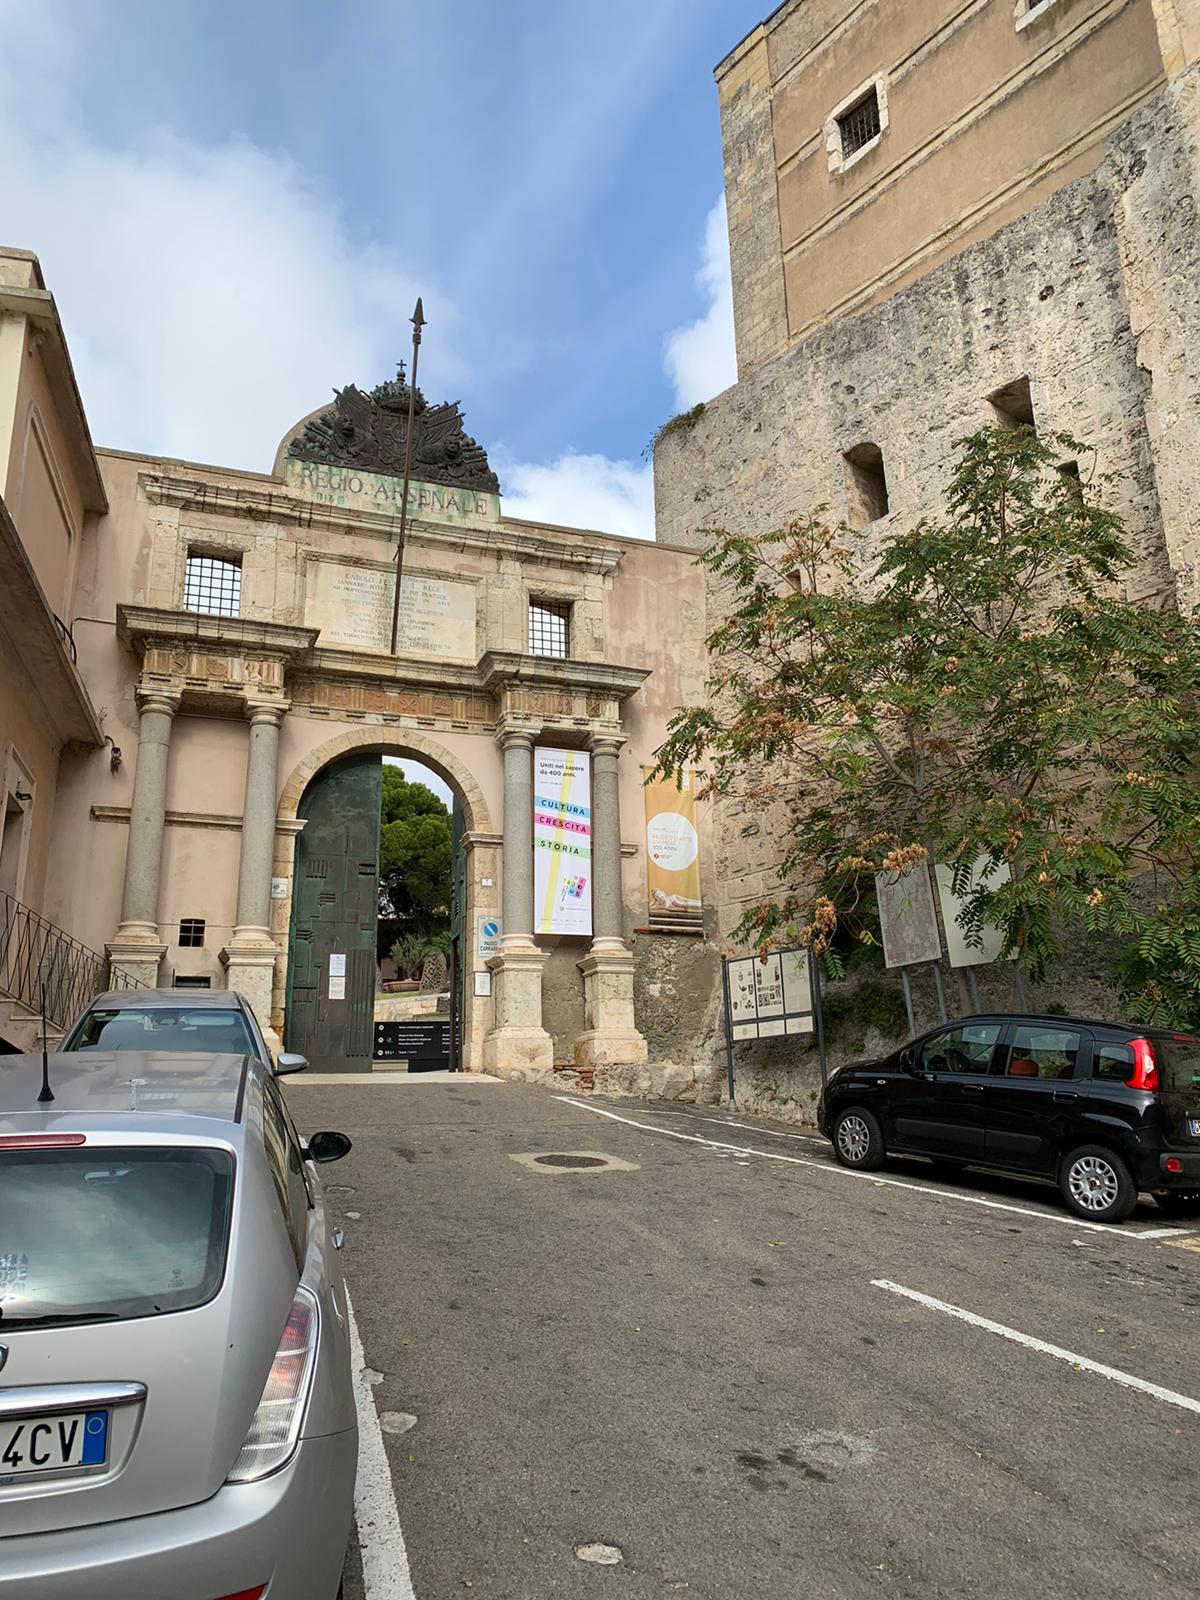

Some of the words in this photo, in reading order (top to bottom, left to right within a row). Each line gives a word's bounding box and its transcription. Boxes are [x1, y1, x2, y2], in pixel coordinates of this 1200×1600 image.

[541, 799, 585, 816] CULTURA
[539, 816, 587, 833] CRESCITA
[540, 840, 579, 855] STORIA
[2, 1420, 79, 1467] 4CV
